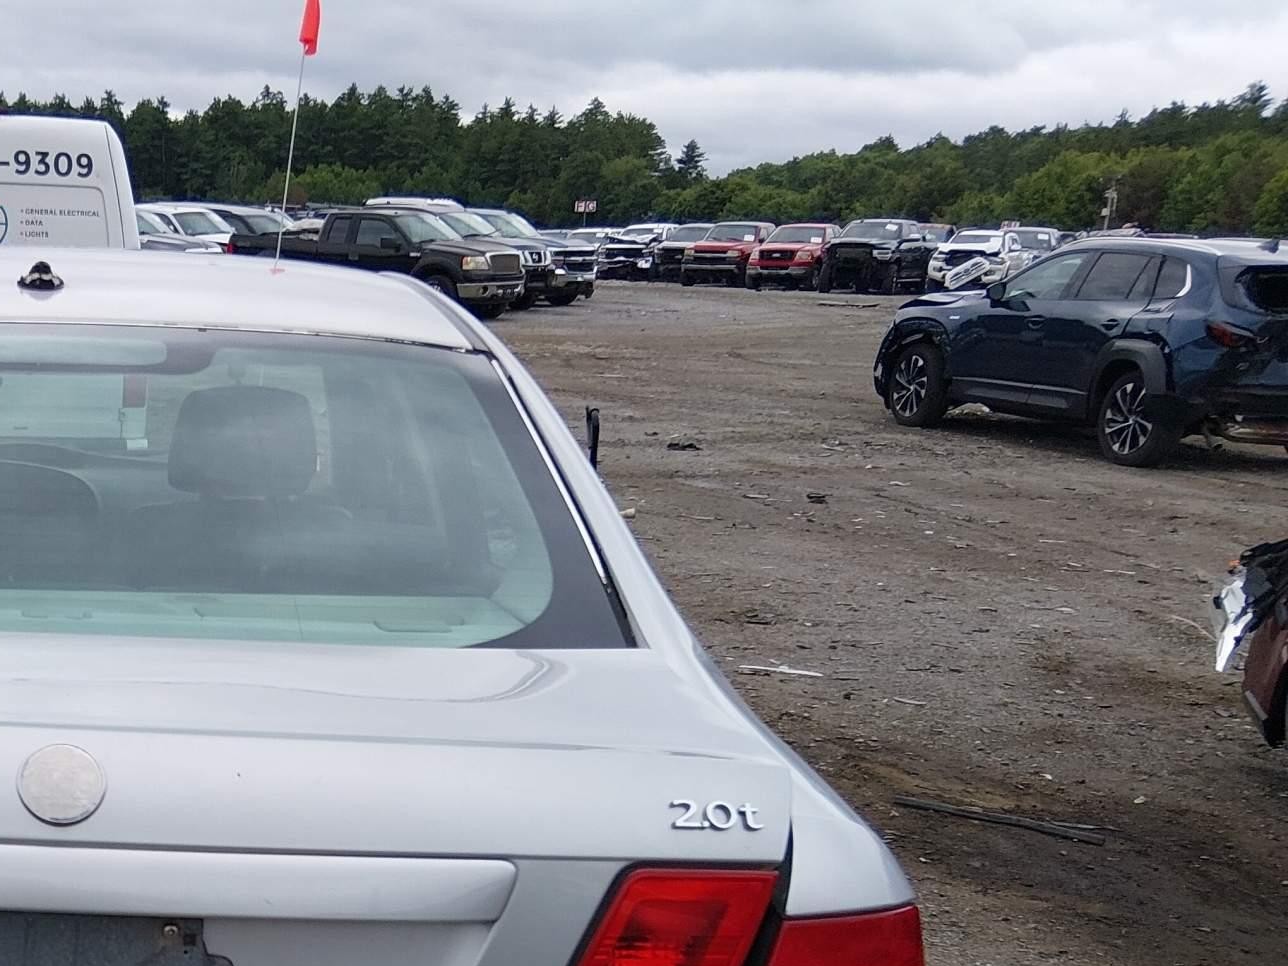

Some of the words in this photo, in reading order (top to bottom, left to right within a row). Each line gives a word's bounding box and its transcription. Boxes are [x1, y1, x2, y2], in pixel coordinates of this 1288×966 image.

[24, 207, 57, 216] GENERAL
[59, 208, 100, 217] ELECTRICAL
[24, 219, 44, 227] DATA
[24, 230, 49, 239] LIGHTS
[669, 799, 765, 832] 2.0t
